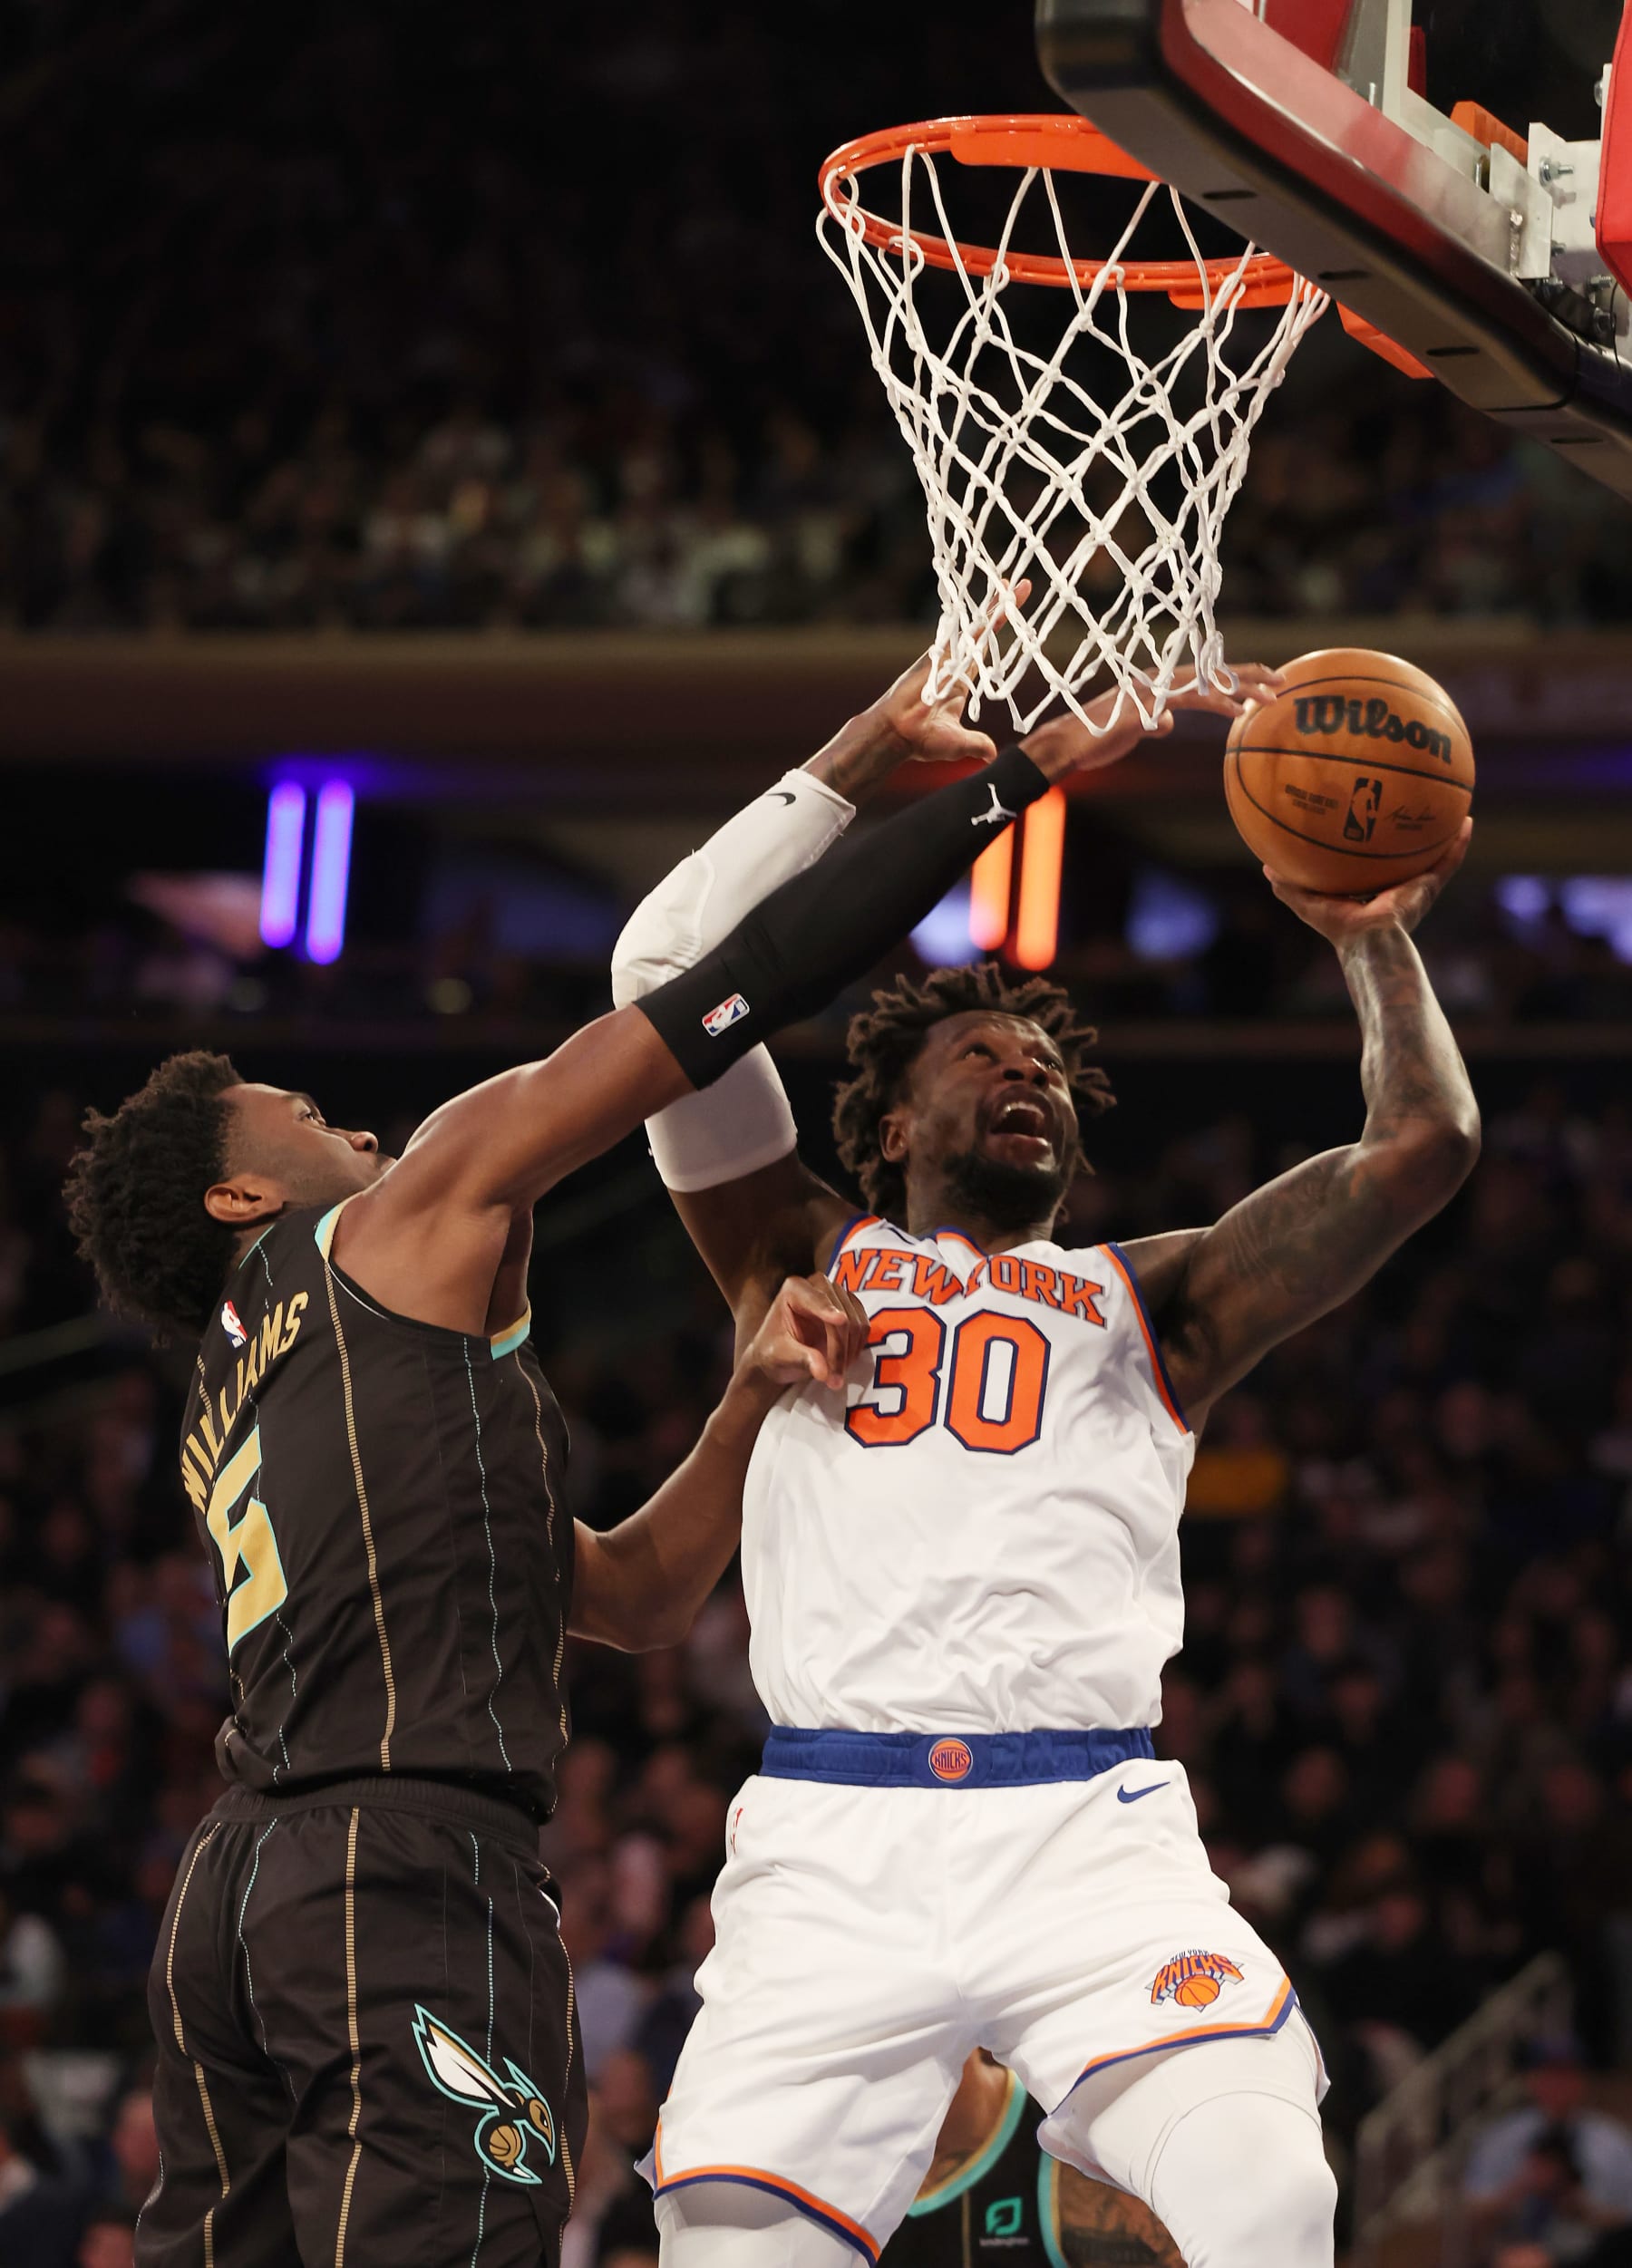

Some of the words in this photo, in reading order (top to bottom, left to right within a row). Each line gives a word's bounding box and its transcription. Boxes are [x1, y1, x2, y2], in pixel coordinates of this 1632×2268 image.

[1293, 695, 1452, 764] Wilson
[834, 1248, 964, 1306] NEW
[181, 1291, 309, 1515] WILLIAMS
[844, 1305, 1052, 1456] 30
[207, 1423, 288, 1659] 5
[934, 1749, 967, 1770] KNICKS
[1151, 1953, 1245, 2005] KNICKS
